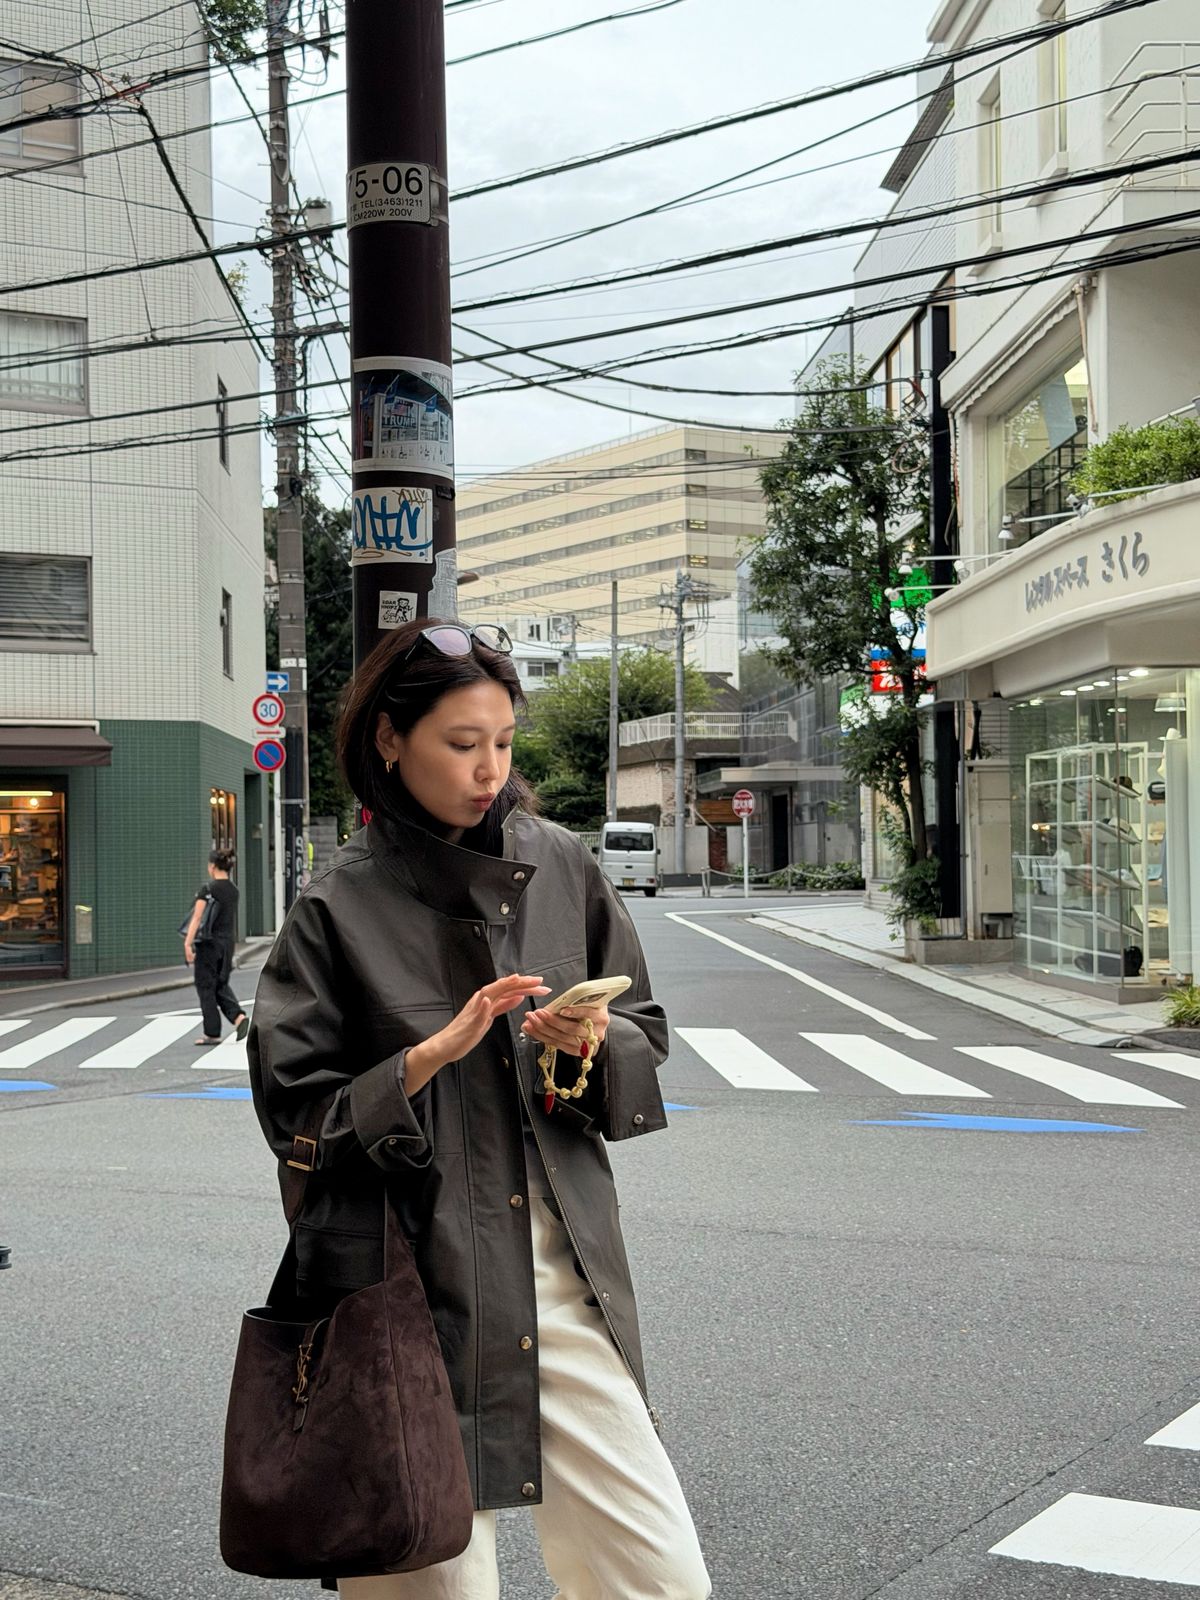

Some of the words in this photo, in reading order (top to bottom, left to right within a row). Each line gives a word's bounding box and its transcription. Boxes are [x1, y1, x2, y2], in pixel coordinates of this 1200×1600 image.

[360, 197, 423, 209] TEL(3463)1211
[389, 208, 413, 217] 200V
[382, 414, 416, 428] TRUMP
[1101, 531, 1150, 583] さくら
[259, 703, 278, 718] 30
